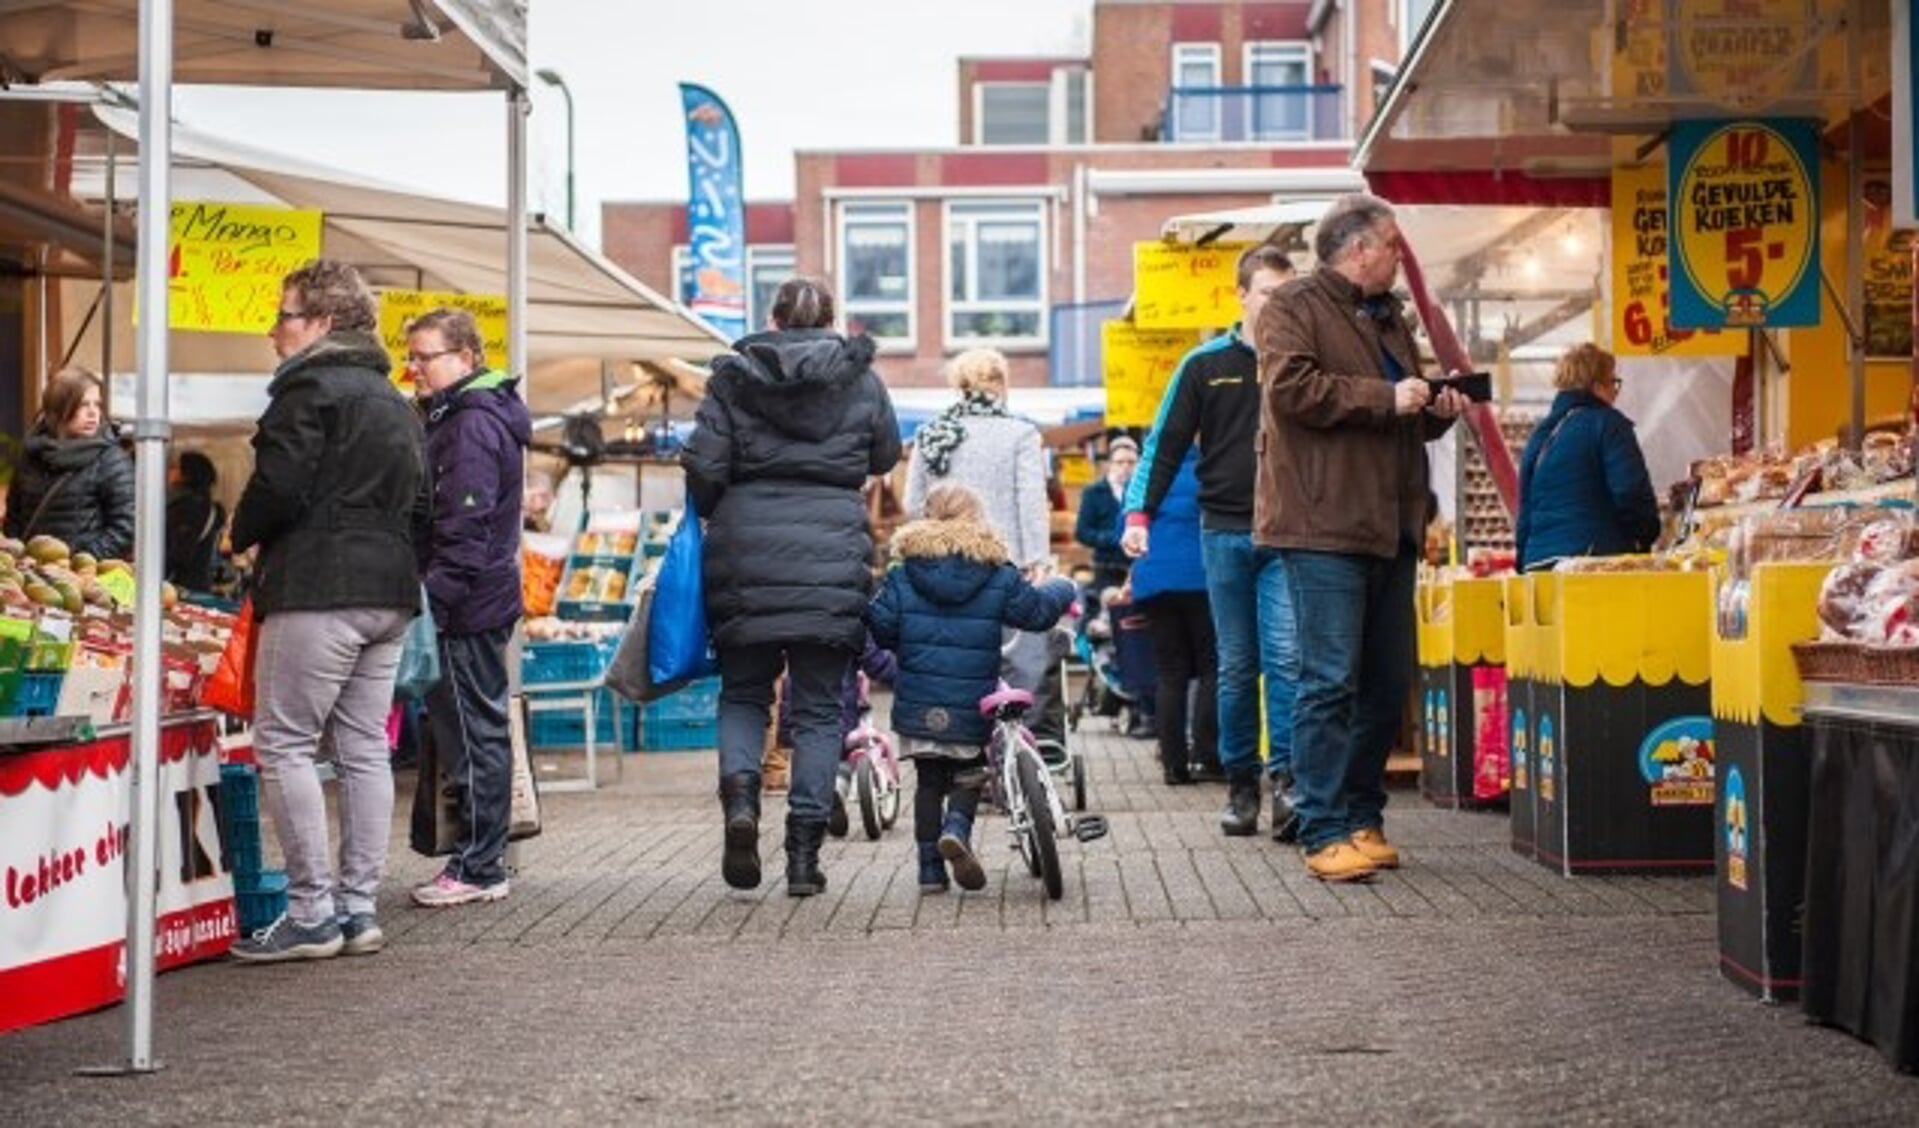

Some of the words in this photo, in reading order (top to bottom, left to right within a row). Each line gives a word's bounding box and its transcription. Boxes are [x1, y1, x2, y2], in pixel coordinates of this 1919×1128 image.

[1726, 131, 1769, 167] 10
[1692, 179, 1798, 207] GEVULDE
[183, 204, 297, 254] Mango
[1695, 202, 1794, 232] KOEKEN
